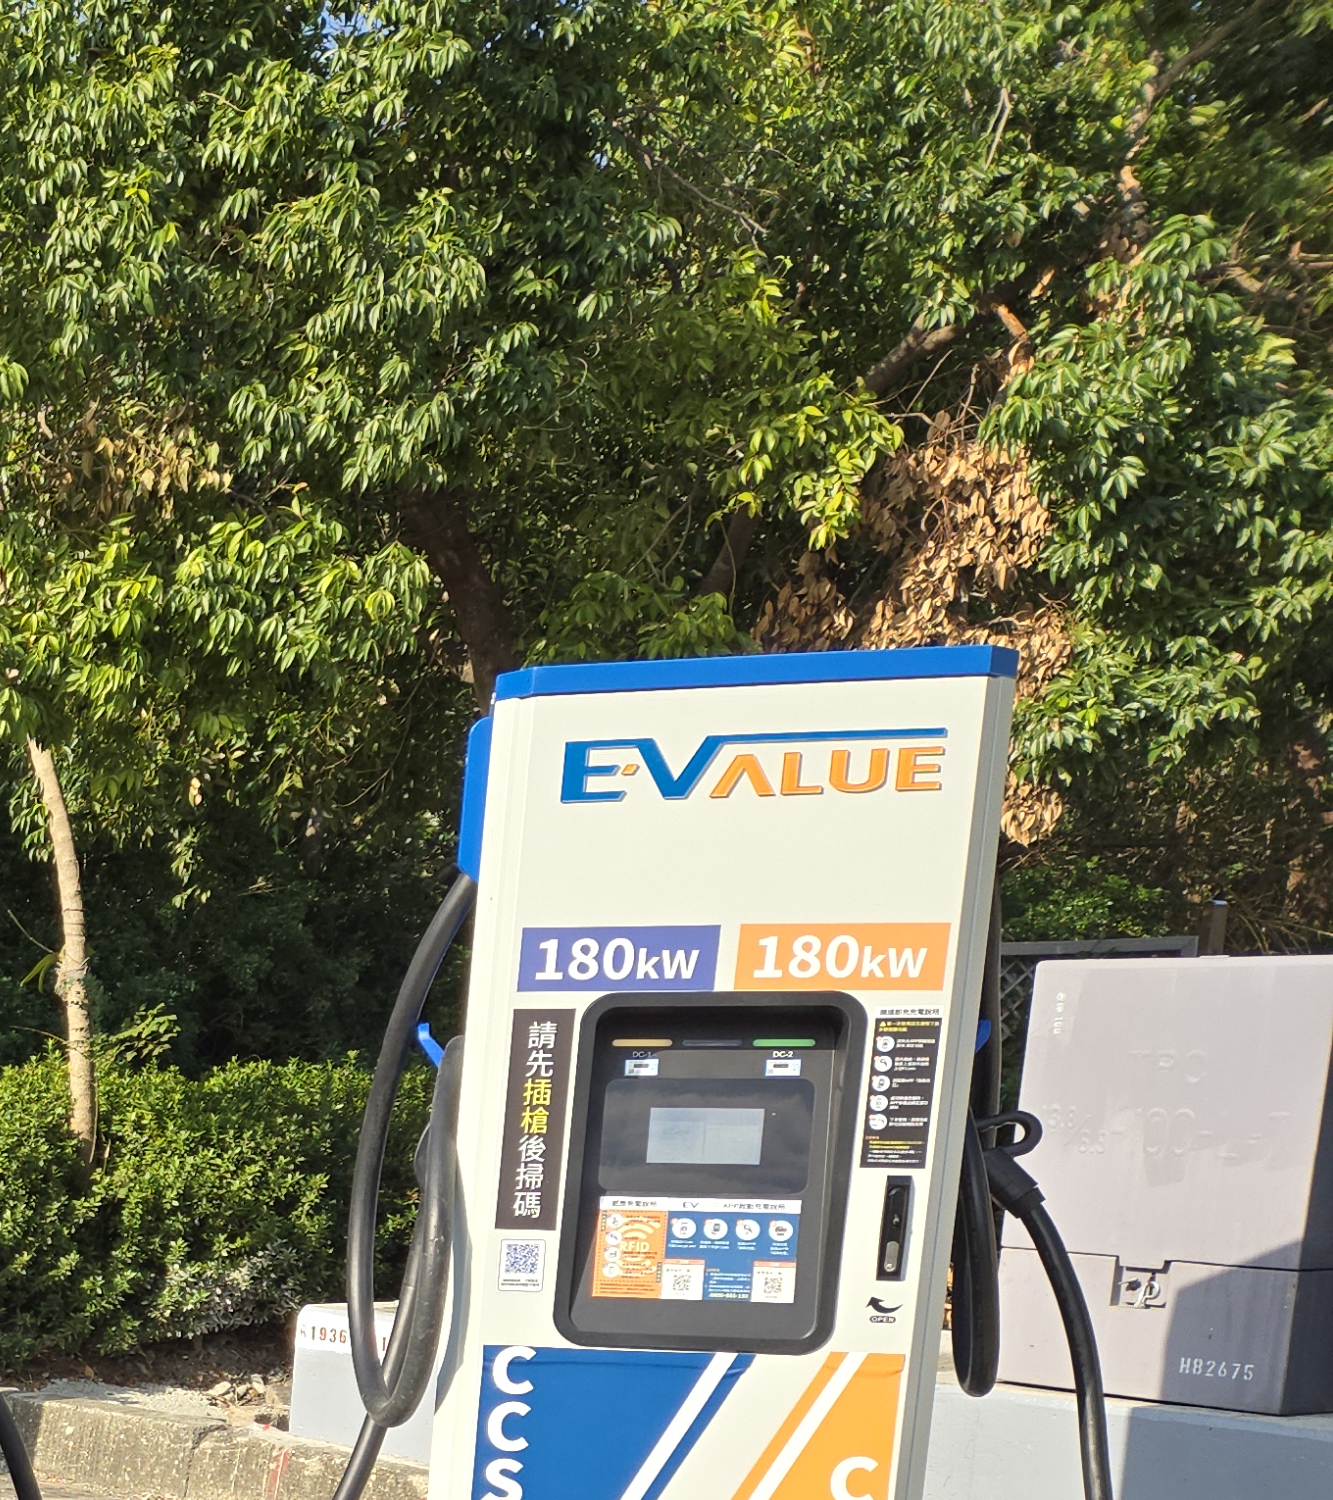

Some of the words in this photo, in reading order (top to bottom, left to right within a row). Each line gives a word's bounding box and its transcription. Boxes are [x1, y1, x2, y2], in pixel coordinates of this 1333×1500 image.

[534, 936, 701, 982] 180kW
[752, 934, 928, 980] 180kW
[772, 1050, 794, 1058] DC-2
[512, 1020, 558, 1219] 請先插槍後掃碼
[1179, 1357, 1255, 1381] H82675
